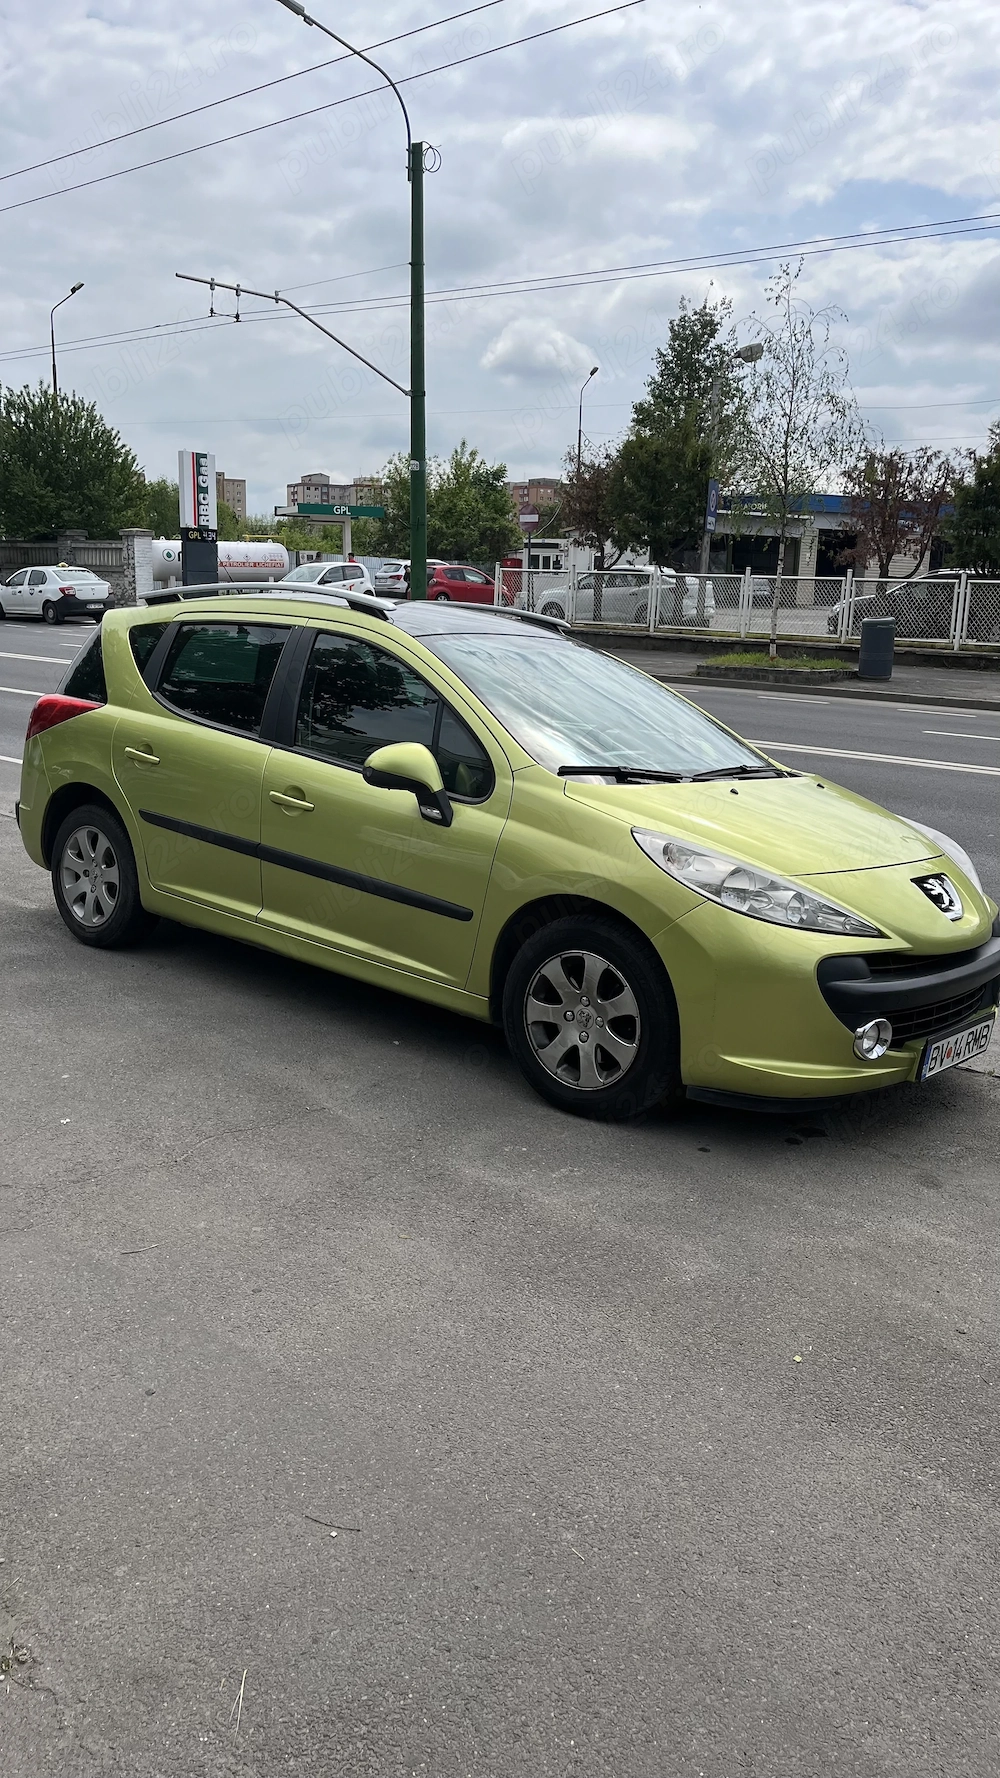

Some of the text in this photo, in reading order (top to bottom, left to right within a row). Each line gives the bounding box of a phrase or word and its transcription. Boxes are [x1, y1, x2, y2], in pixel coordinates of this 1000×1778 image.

[333, 505, 351, 515] GPL
[188, 530, 202, 540] GPL
[928, 1024, 990, 1073] BV 14 RMB
